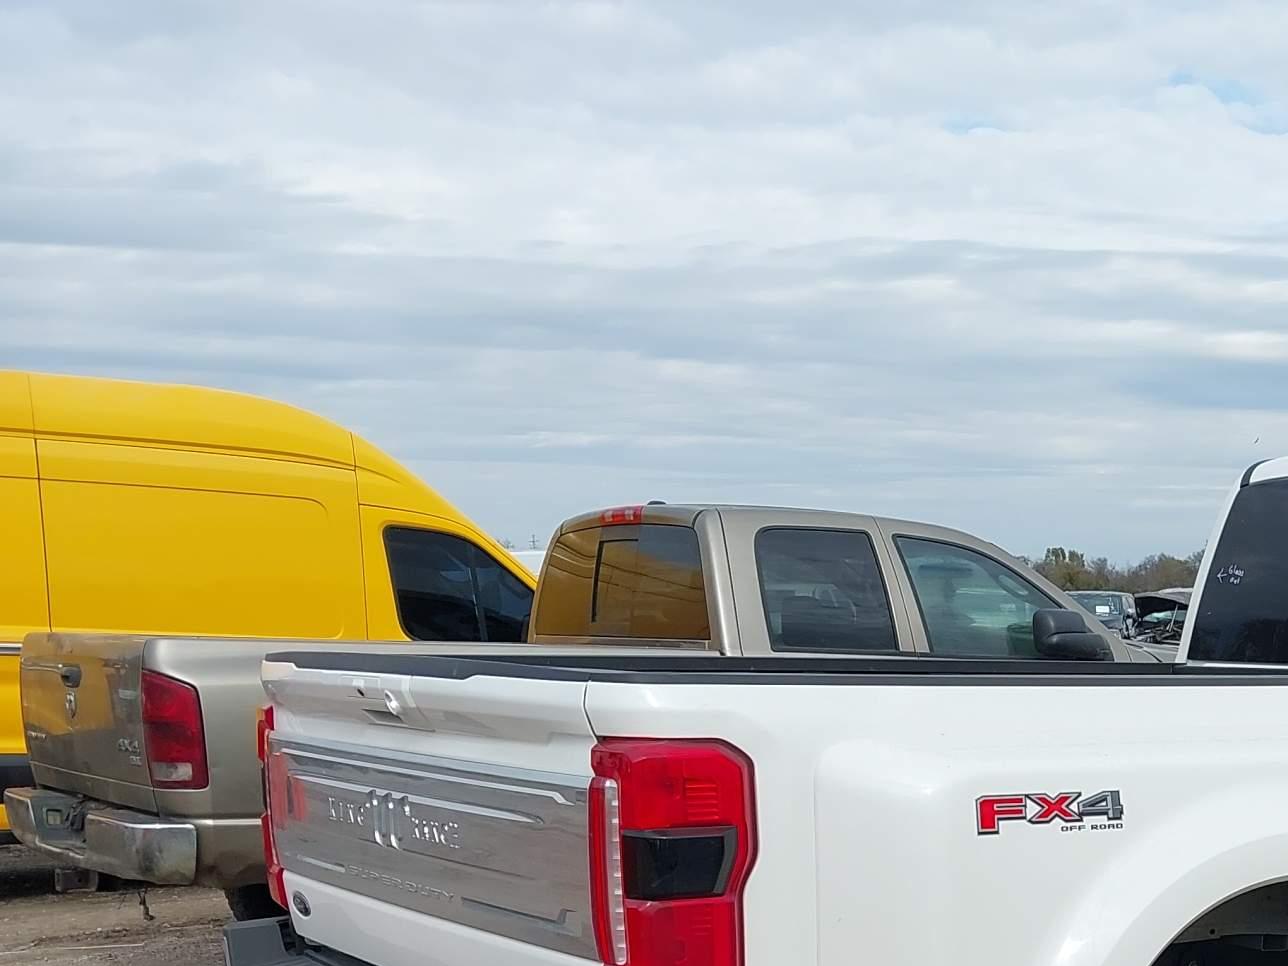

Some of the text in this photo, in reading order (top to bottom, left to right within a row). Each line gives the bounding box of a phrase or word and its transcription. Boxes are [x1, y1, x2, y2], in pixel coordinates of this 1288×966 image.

[975, 789, 1124, 835] FX4
[1060, 822, 1124, 833] OFF ROAD
